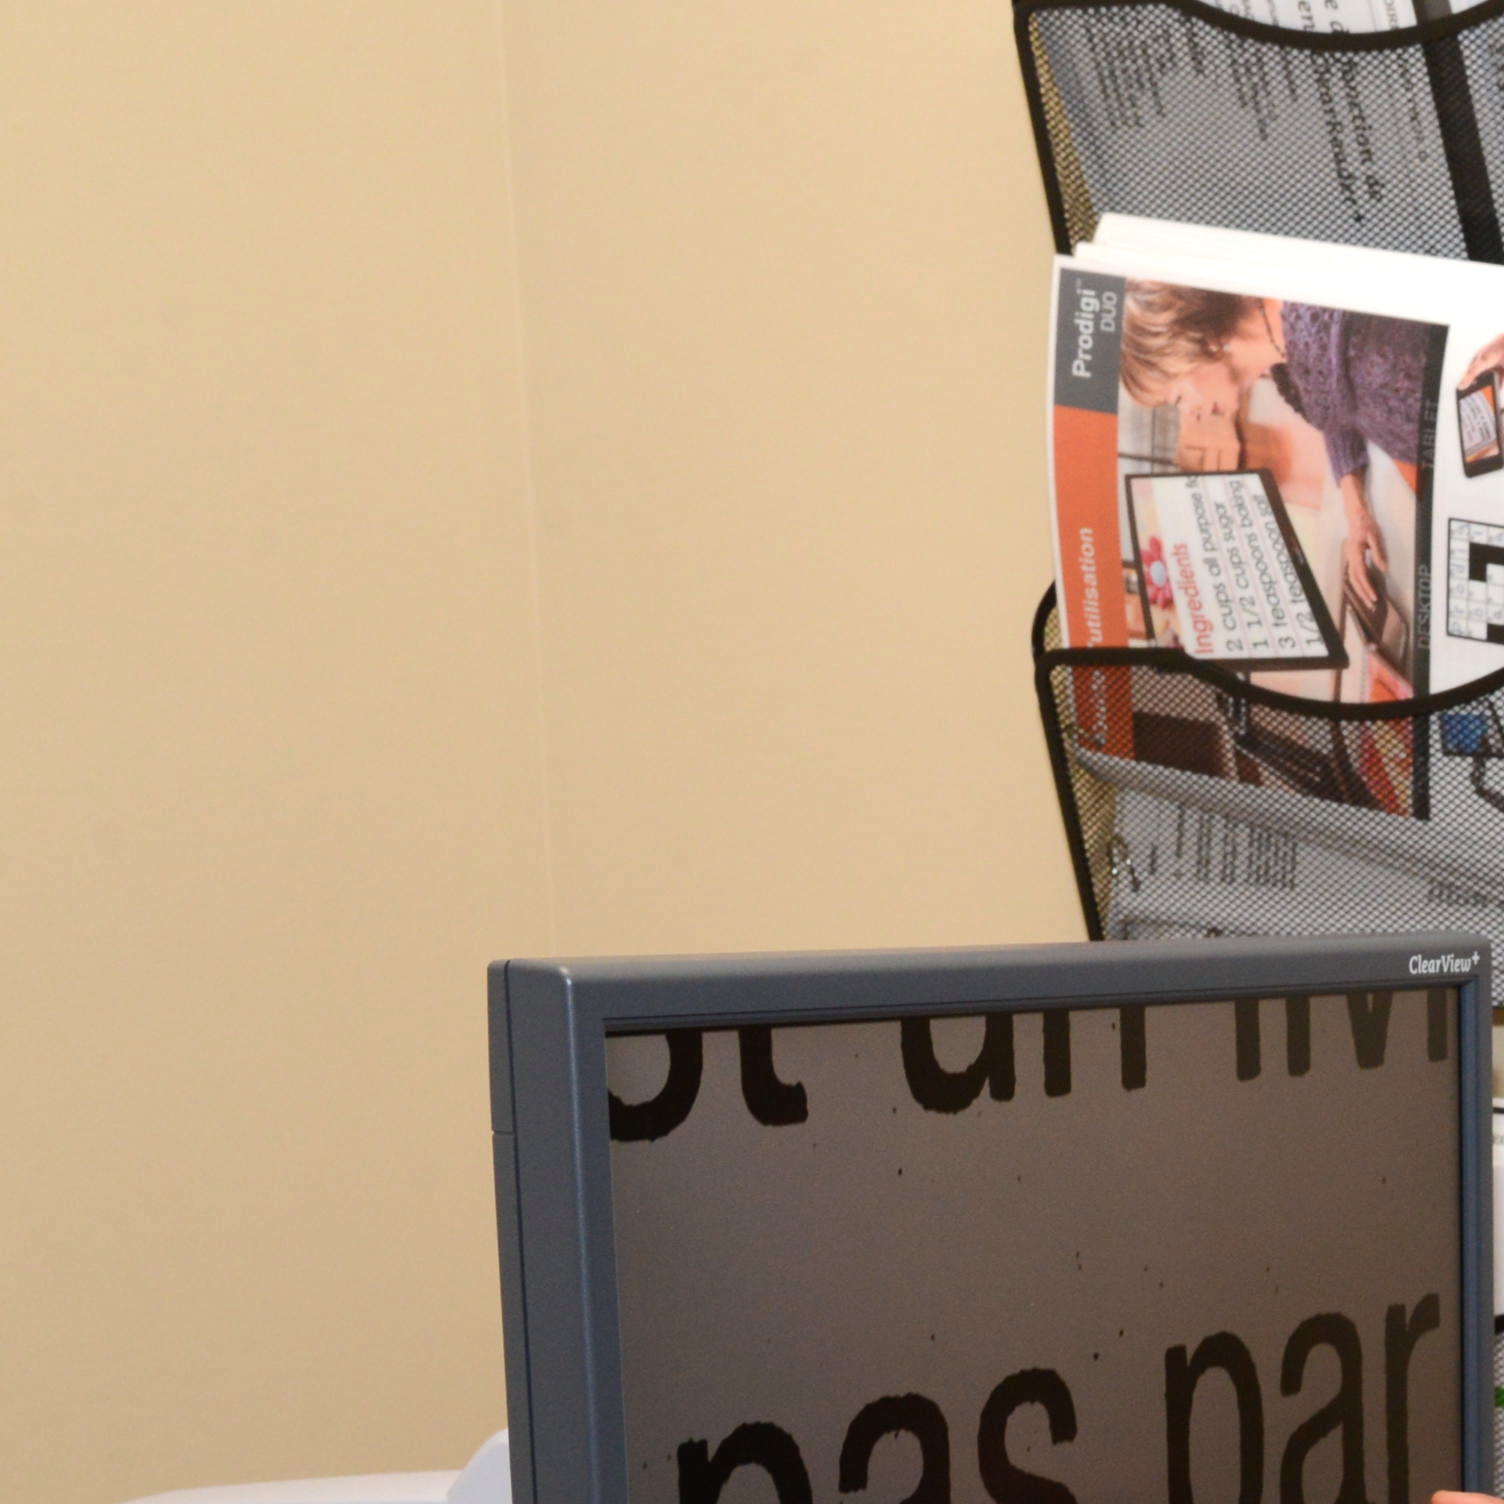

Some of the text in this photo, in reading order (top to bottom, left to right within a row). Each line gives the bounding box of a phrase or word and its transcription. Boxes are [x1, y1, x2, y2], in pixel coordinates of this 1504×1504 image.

[1071, 286, 1100, 380] Prodigi
[1100, 291, 1118, 334] DUO
[1190, 492, 1217, 554] purpose
[1170, 543, 1215, 655] Ingredients
[1202, 556, 1222, 577] all
[1213, 501, 1270, 650] 1 1/2 cups sugar
[1228, 478, 1297, 649] 3 teaspoons baking
[1263, 520, 1307, 605] teaspoon
[1213, 582, 1238, 631] cups
[1226, 638, 1244, 653] 2
